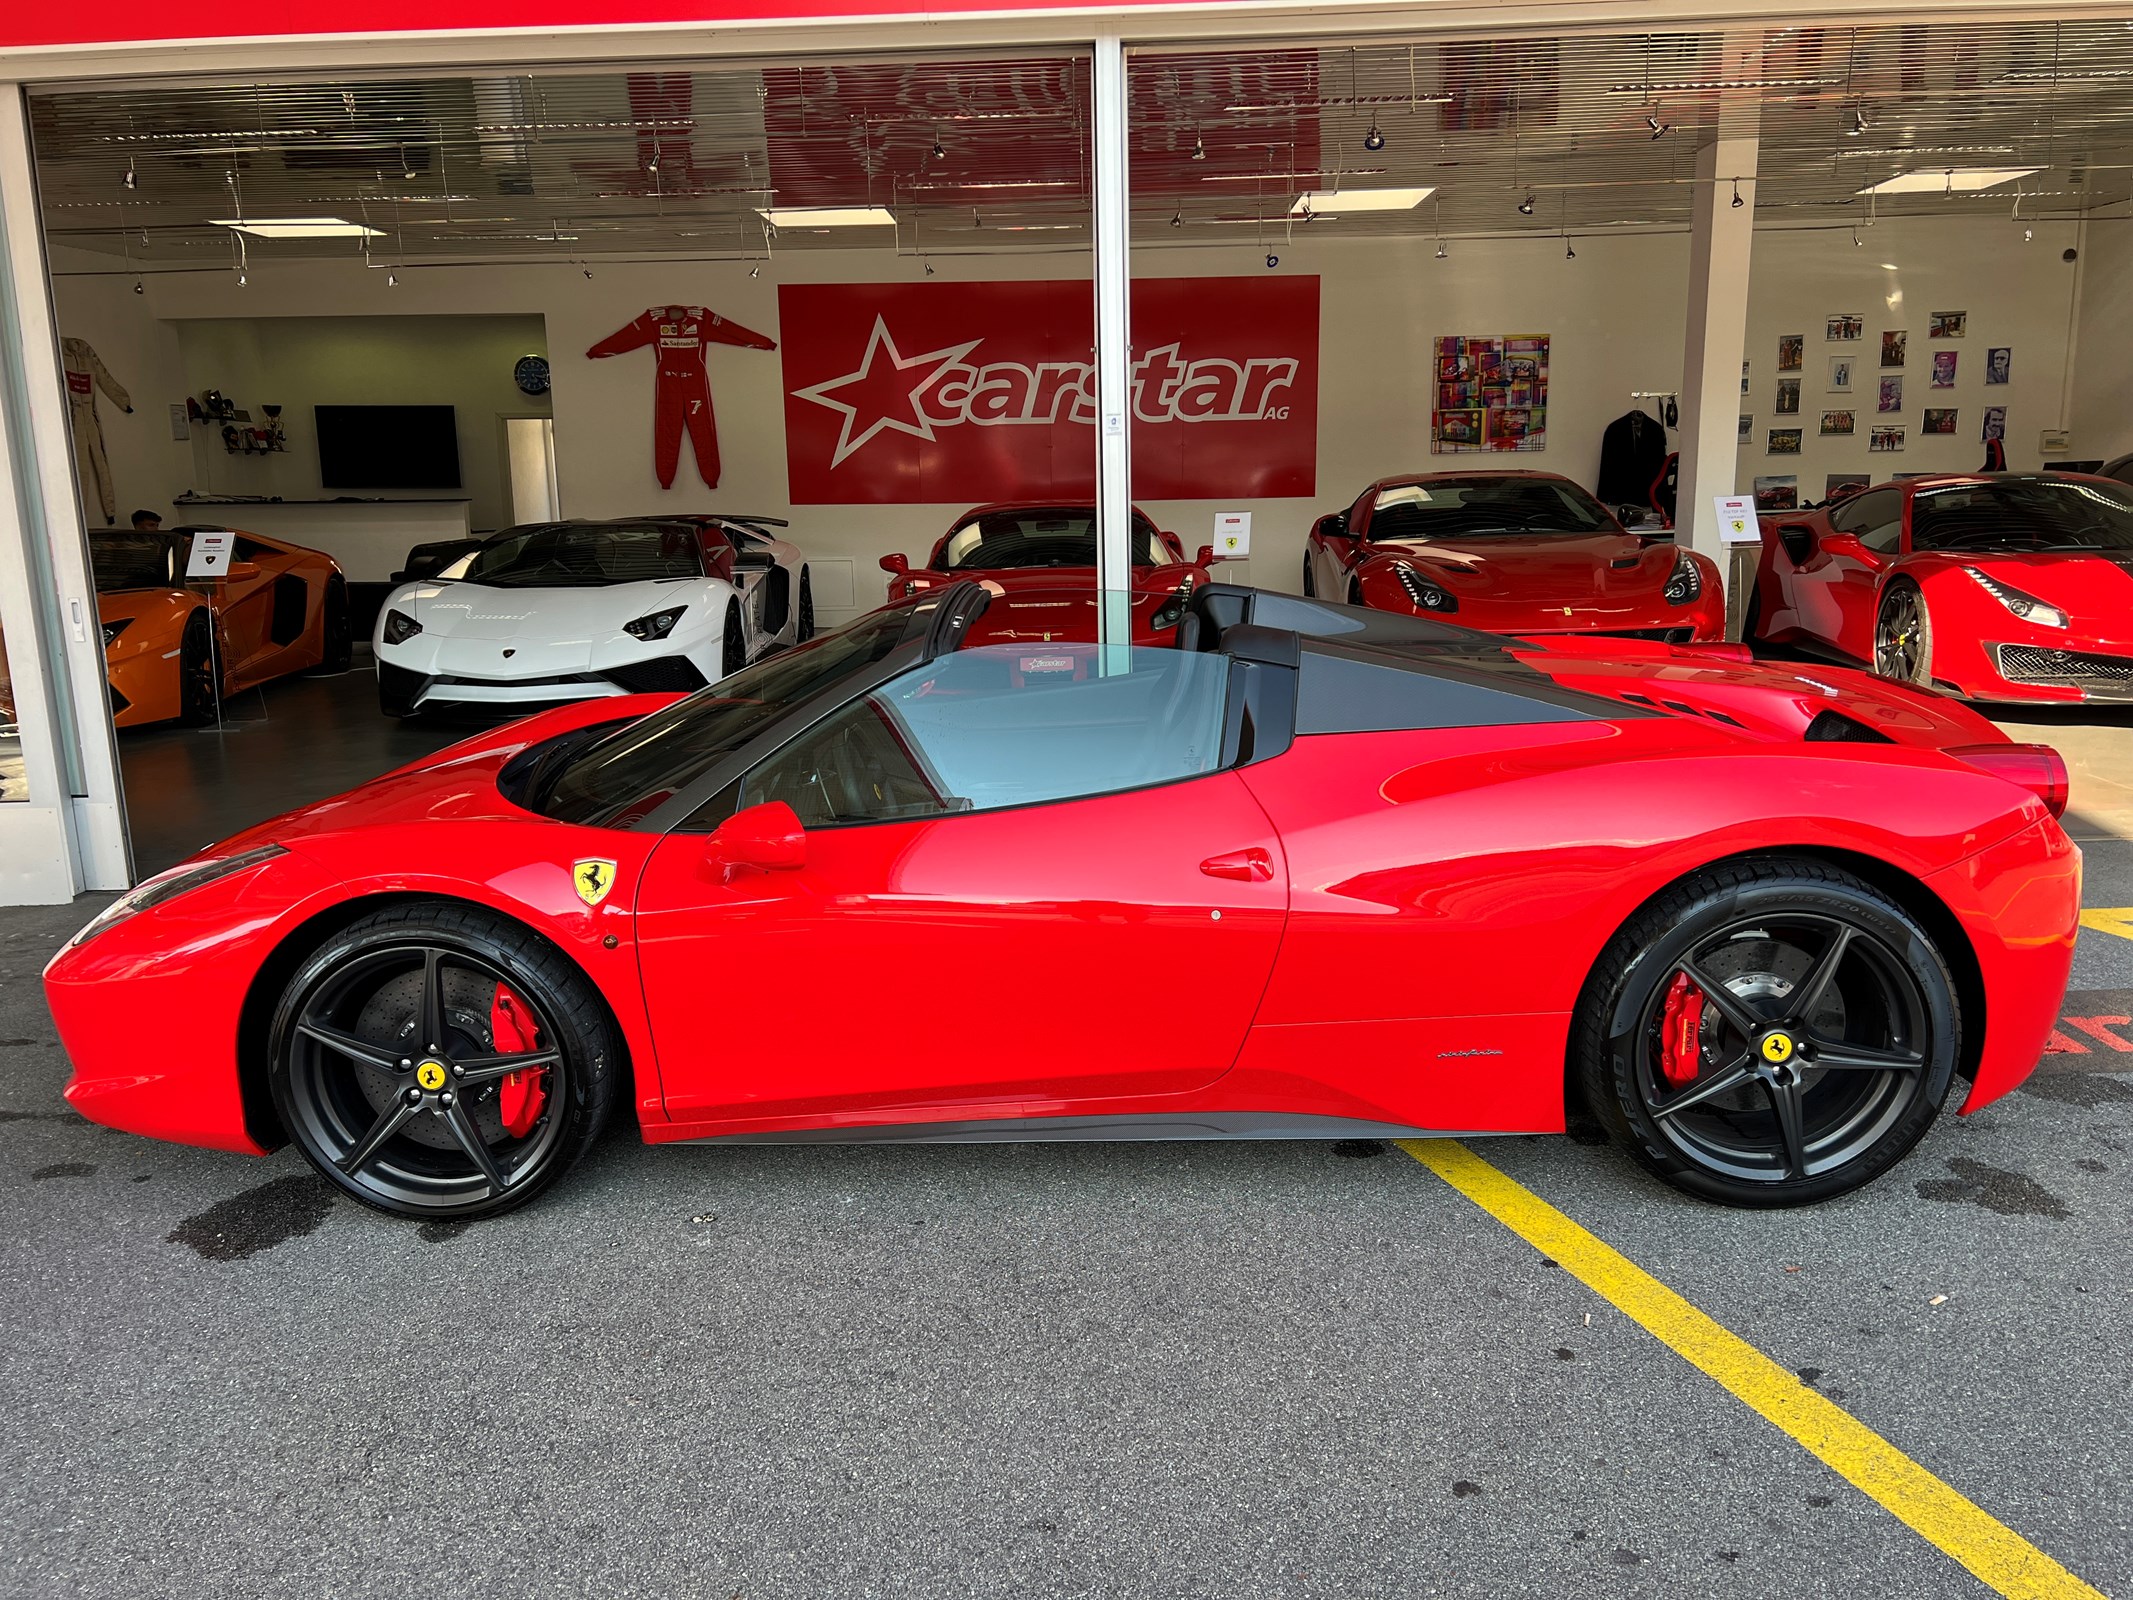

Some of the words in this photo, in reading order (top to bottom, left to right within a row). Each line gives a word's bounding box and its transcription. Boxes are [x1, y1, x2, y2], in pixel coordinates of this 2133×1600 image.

[690, 400, 702, 415] 7
[1264, 406, 1290, 420] AG
[1816, 896, 1860, 913] ZR20
[1687, 1021, 1696, 1053] Ferrari
[1613, 1053, 1650, 1138] ZERO
[1645, 1145, 1668, 1159] P
